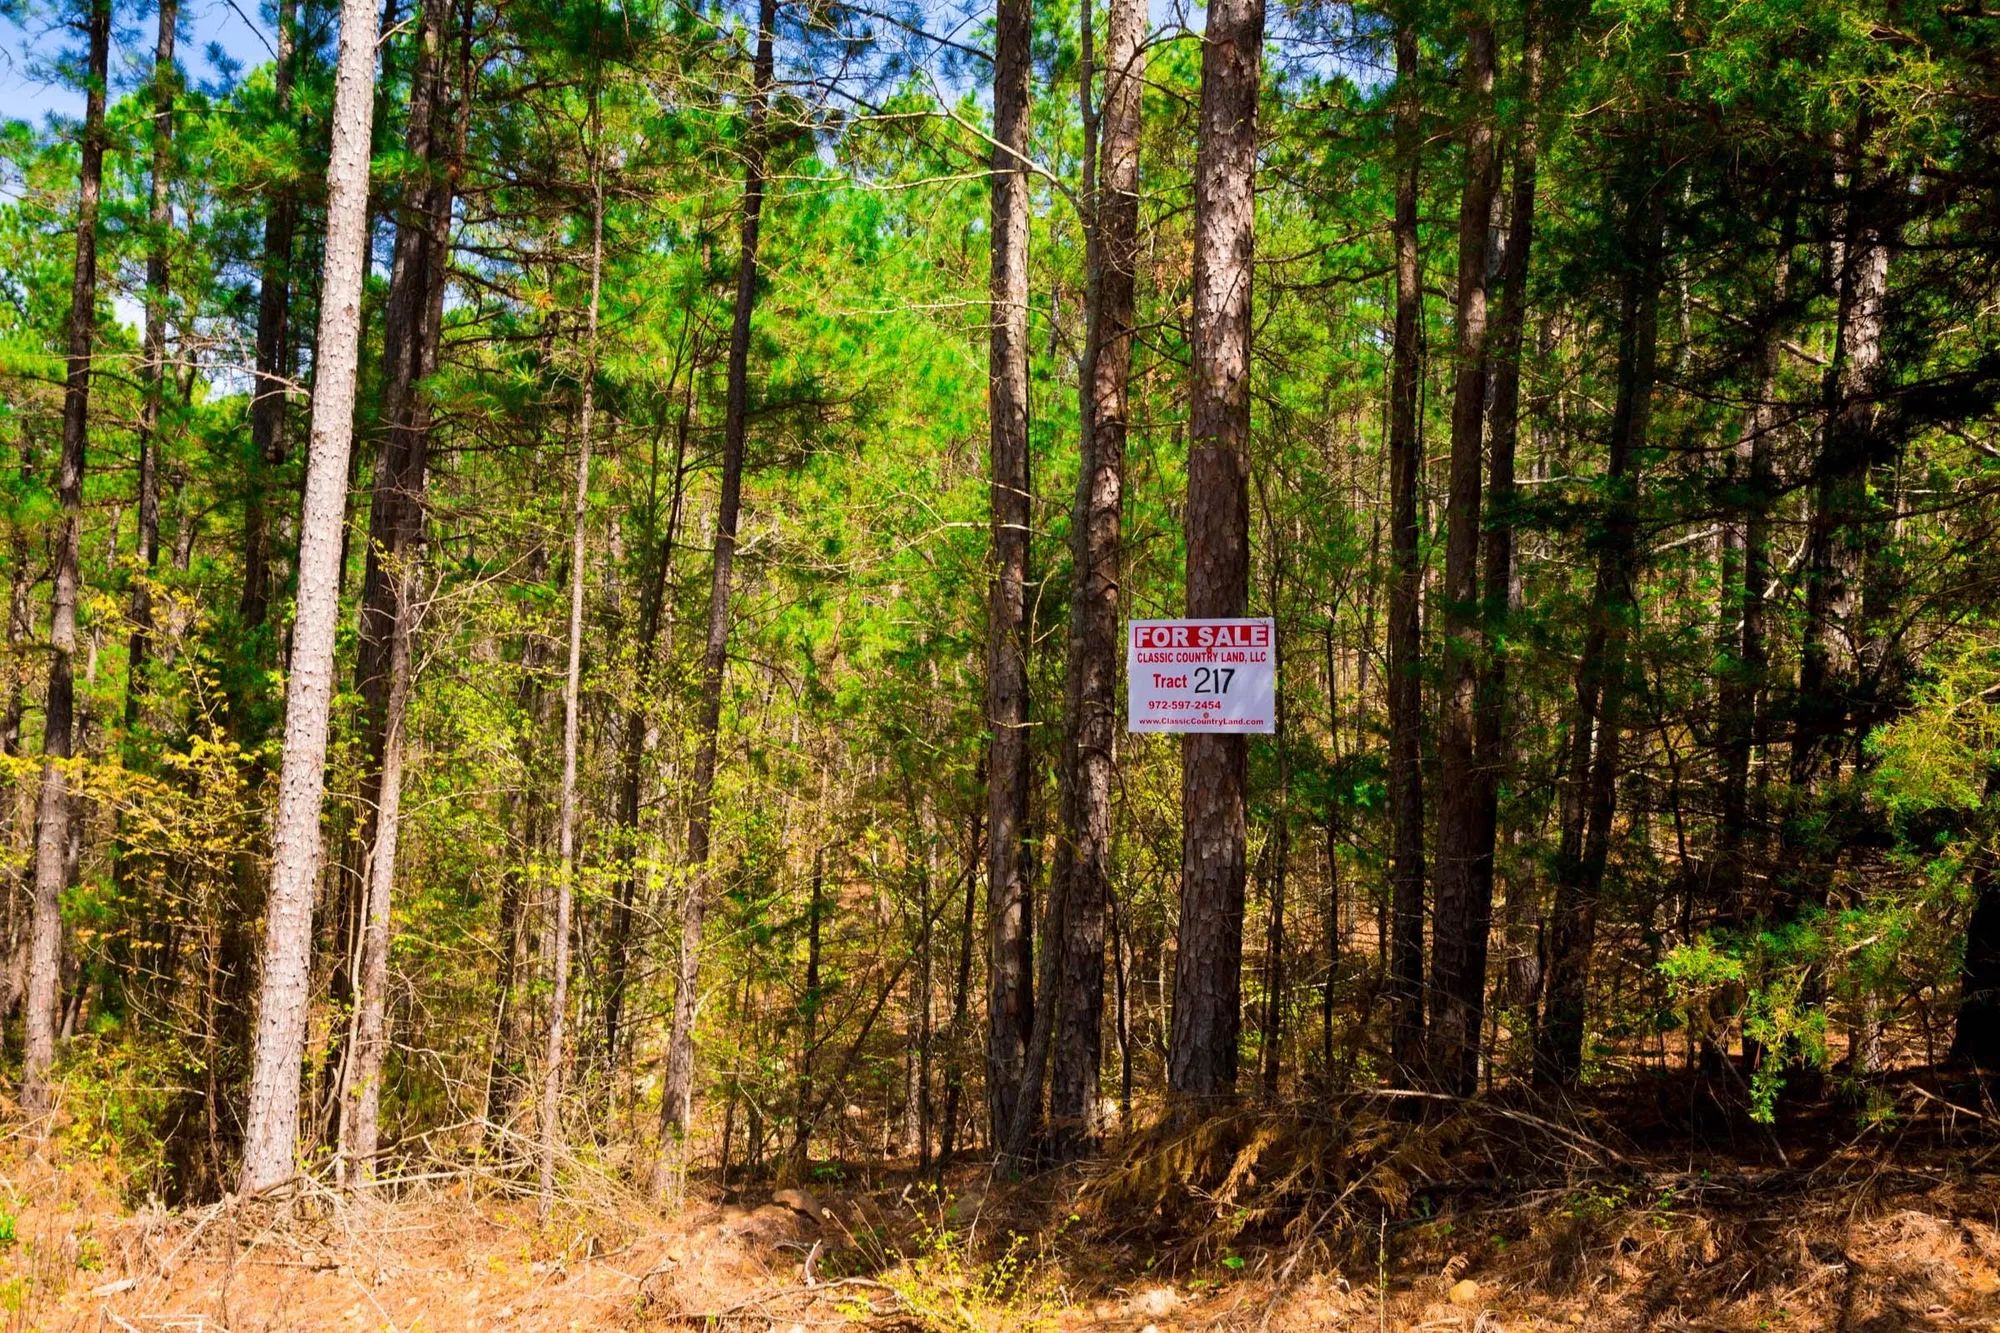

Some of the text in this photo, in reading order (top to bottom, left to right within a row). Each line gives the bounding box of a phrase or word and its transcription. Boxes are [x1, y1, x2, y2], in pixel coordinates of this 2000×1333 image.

[1136, 626, 1268, 647] FOR SALE
[1137, 651, 1266, 664] CLASSIC COUNTRY LAND, LLC
[1153, 667, 1235, 694] Tract 217
[1148, 701, 1221, 710] 972-597-2454
[1139, 717, 1264, 726] www.ClassicCountryLand.com
